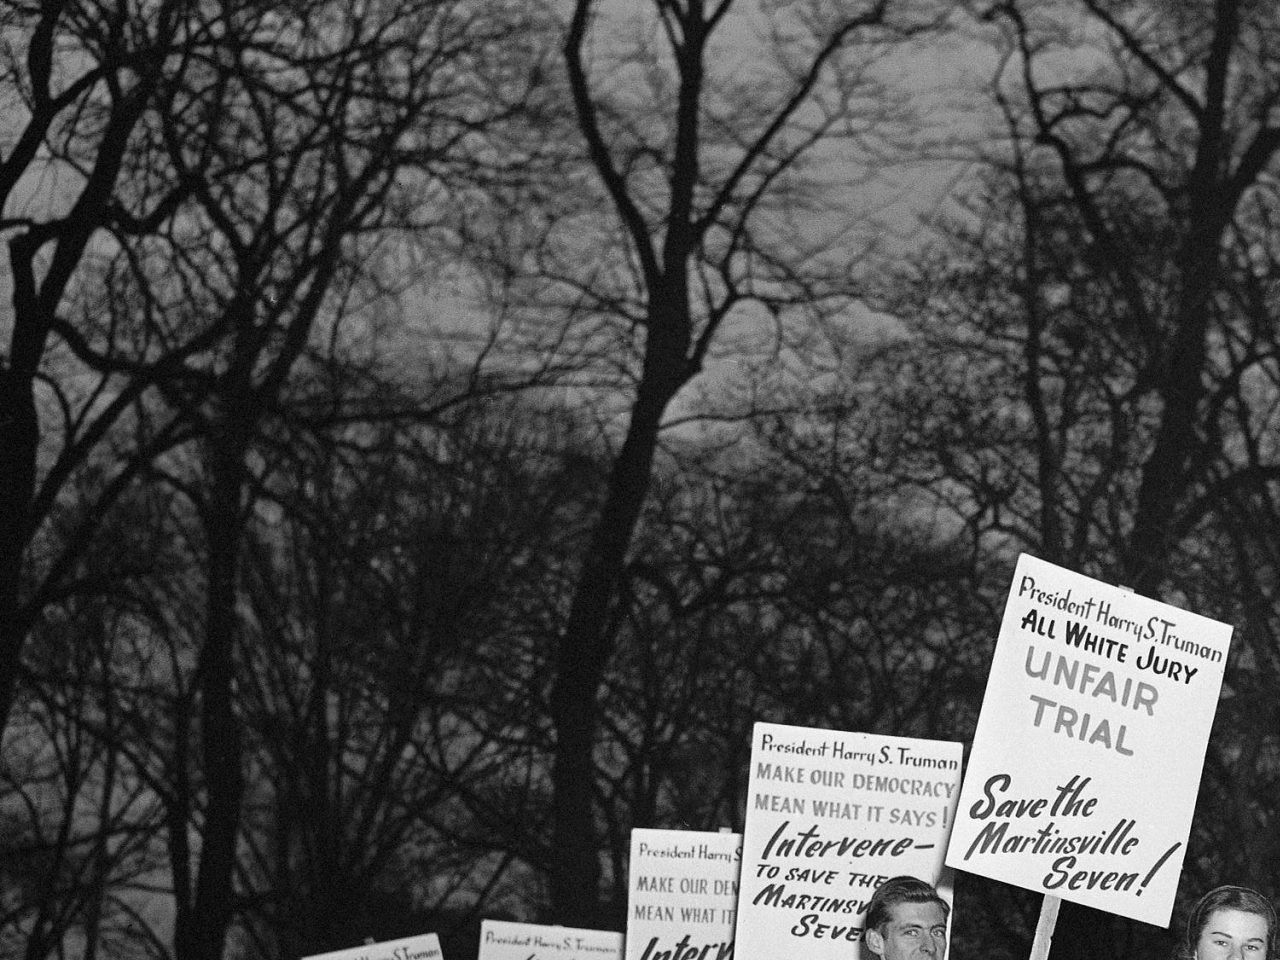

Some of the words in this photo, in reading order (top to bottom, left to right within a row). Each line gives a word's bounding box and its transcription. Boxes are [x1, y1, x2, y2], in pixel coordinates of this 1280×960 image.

[1019, 576, 1096, 619] President
[1097, 600, 1142, 642] Harry
[1143, 617, 1159, 642] S.
[1160, 619, 1222, 662] Truman
[1021, 609, 1055, 639] ALL
[1066, 620, 1129, 663] WHITE
[1136, 646, 1198, 684] JURY
[1025, 646, 1159, 716] UNFAIR
[1030, 694, 1134, 756] TRIAL
[761, 734, 829, 756] President
[832, 742, 875, 765] Harry
[878, 746, 893, 765] S.
[898, 748, 958, 770] Truman
[756, 763, 804, 783] MAKE
[810, 769, 845, 788] OUR
[853, 774, 955, 798] DEMOCRACY
[970, 774, 1048, 820] Save
[1050, 775, 1098, 817] the
[755, 794, 805, 815] MEAN
[812, 800, 862, 821] WHAT
[867, 806, 884, 822] IT
[639, 842, 695, 859] President
[698, 844, 732, 862] Harry
[964, 818, 1139, 860] Martinsville
[637, 876, 674, 893] MAKE
[680, 878, 708, 895] OUR
[756, 864, 780, 878] TO
[785, 867, 839, 885] SAVE
[849, 872, 888, 888] THE
[1042, 842, 1182, 896] Seven!
[635, 905, 674, 922] MEAN
[680, 907, 714, 923] WHAT
[722, 909, 735, 925] IT
[752, 883, 871, 915] MARTINSV
[486, 931, 531, 945] President
[534, 936, 560, 949] Harry
[791, 914, 864, 942] SEVE
